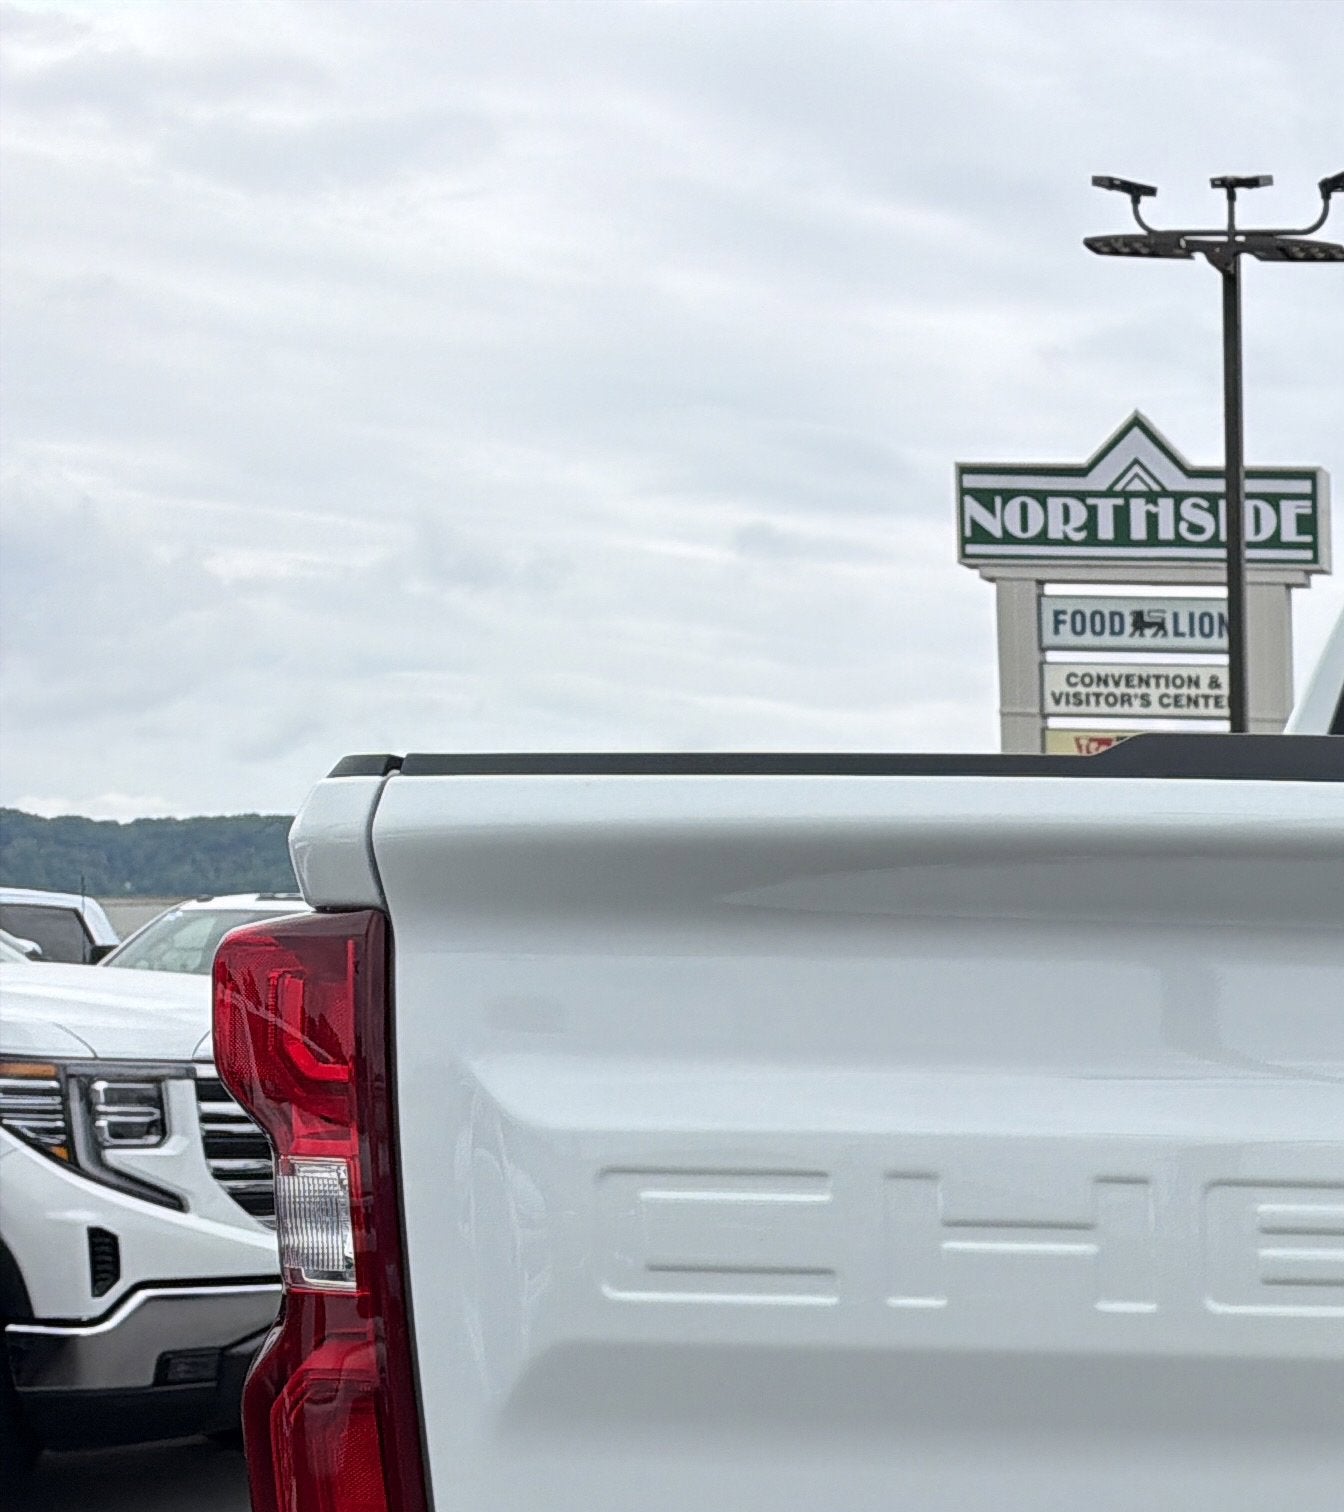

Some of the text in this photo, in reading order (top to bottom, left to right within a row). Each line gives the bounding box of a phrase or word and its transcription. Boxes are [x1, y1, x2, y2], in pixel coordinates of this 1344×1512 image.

[963, 495, 1313, 543] NORTHSIDE
[1053, 610, 1125, 637] FOOD
[1066, 672, 1222, 690] CONVENTION &
[1051, 691, 1228, 709] VISITOR'S CENTE
